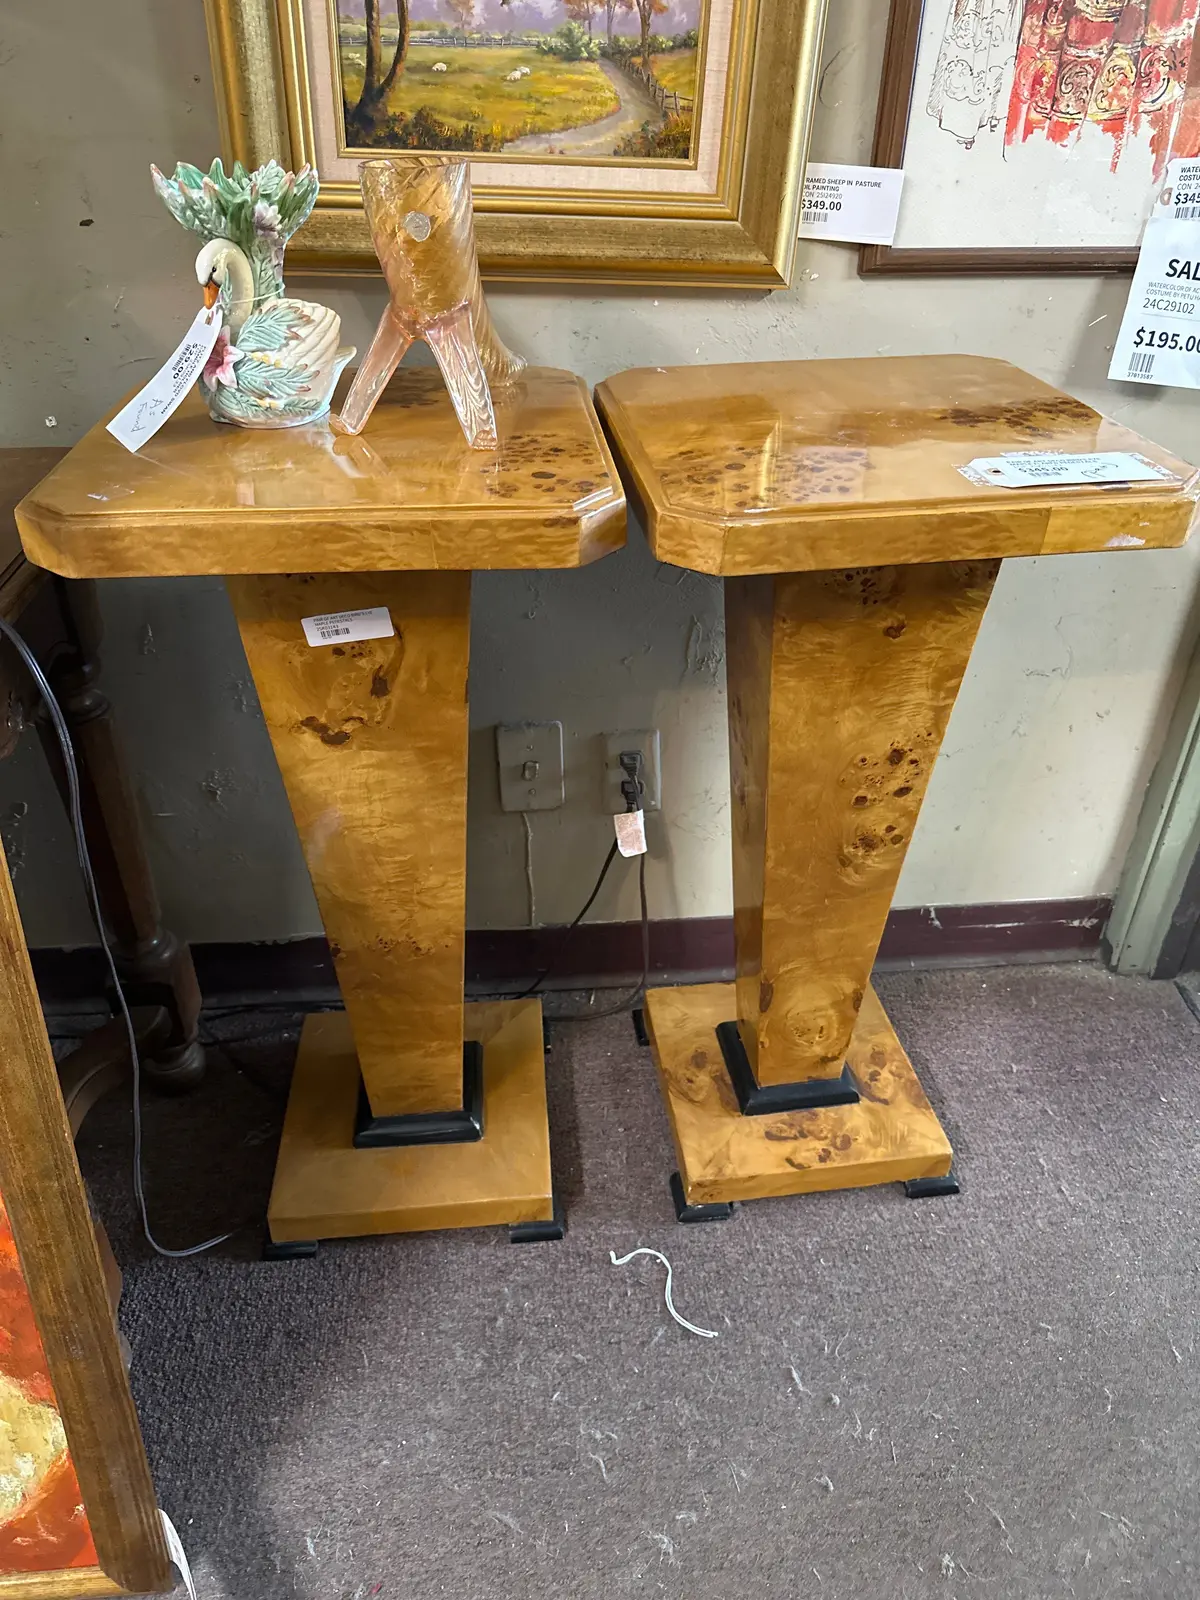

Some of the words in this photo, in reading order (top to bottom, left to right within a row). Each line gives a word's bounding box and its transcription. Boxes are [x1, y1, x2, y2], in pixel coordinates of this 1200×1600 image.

[801, 198, 842, 211] $349.00
[1174, 192, 1200, 206] $345
[1165, 258, 1200, 281] SAL
[1146, 288, 1172, 297] COSTUME
[1148, 282, 1185, 291] WATERCOLOR
[1142, 298, 1195, 314] 24C29102
[173, 343, 198, 380] $29.00
